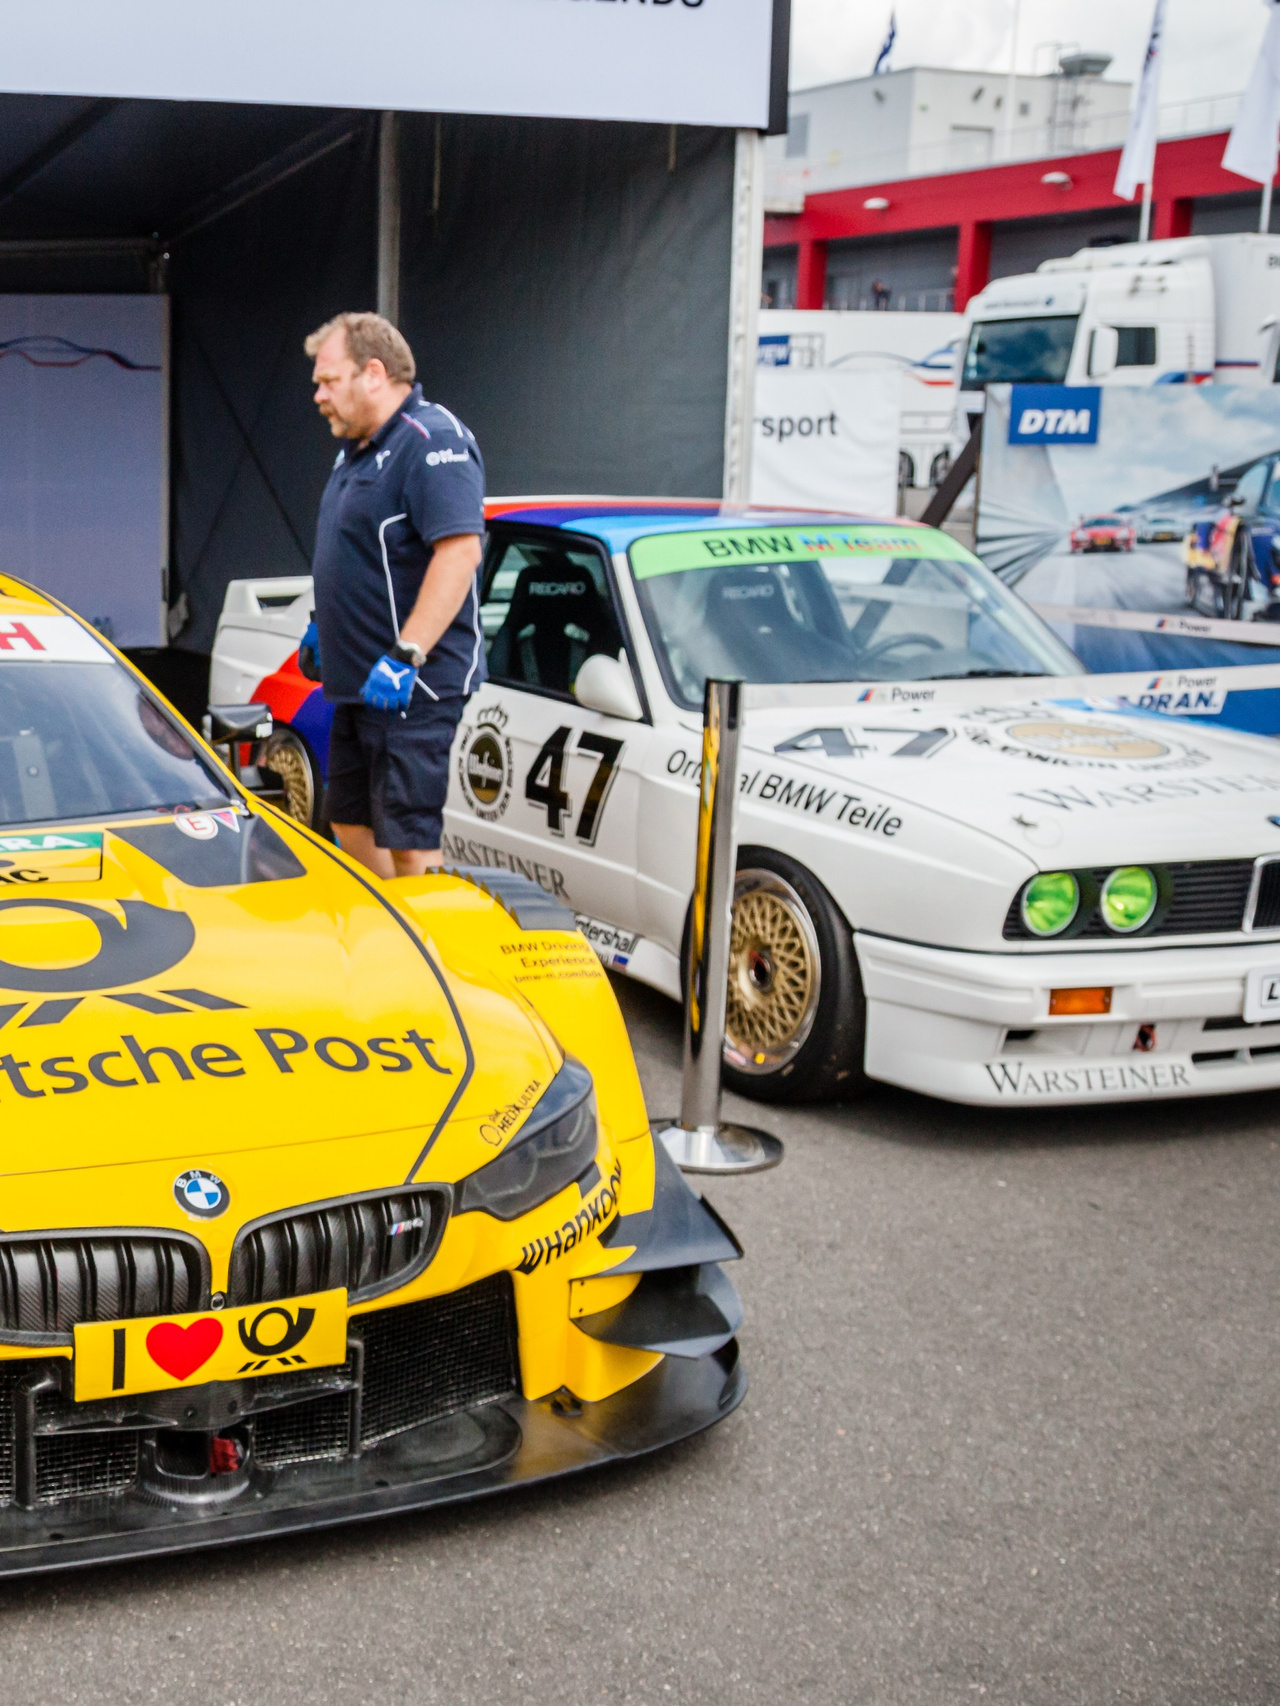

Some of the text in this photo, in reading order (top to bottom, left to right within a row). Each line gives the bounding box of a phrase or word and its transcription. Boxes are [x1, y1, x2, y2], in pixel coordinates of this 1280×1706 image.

[754, 411, 837, 442] sport
[1018, 409, 1091, 434] DTM
[703, 536, 794, 558] BMW
[892, 688, 936, 702] Power
[774, 727, 956, 758] 47
[525, 726, 627, 847] 47
[759, 774, 835, 816] BMW
[836, 795, 903, 837] Teile
[254, 1027, 452, 1075] Post
[985, 1060, 1191, 1094] WARSTEINER
[176, 1170, 221, 1188] BMW
[112, 1328, 126, 1390] I
